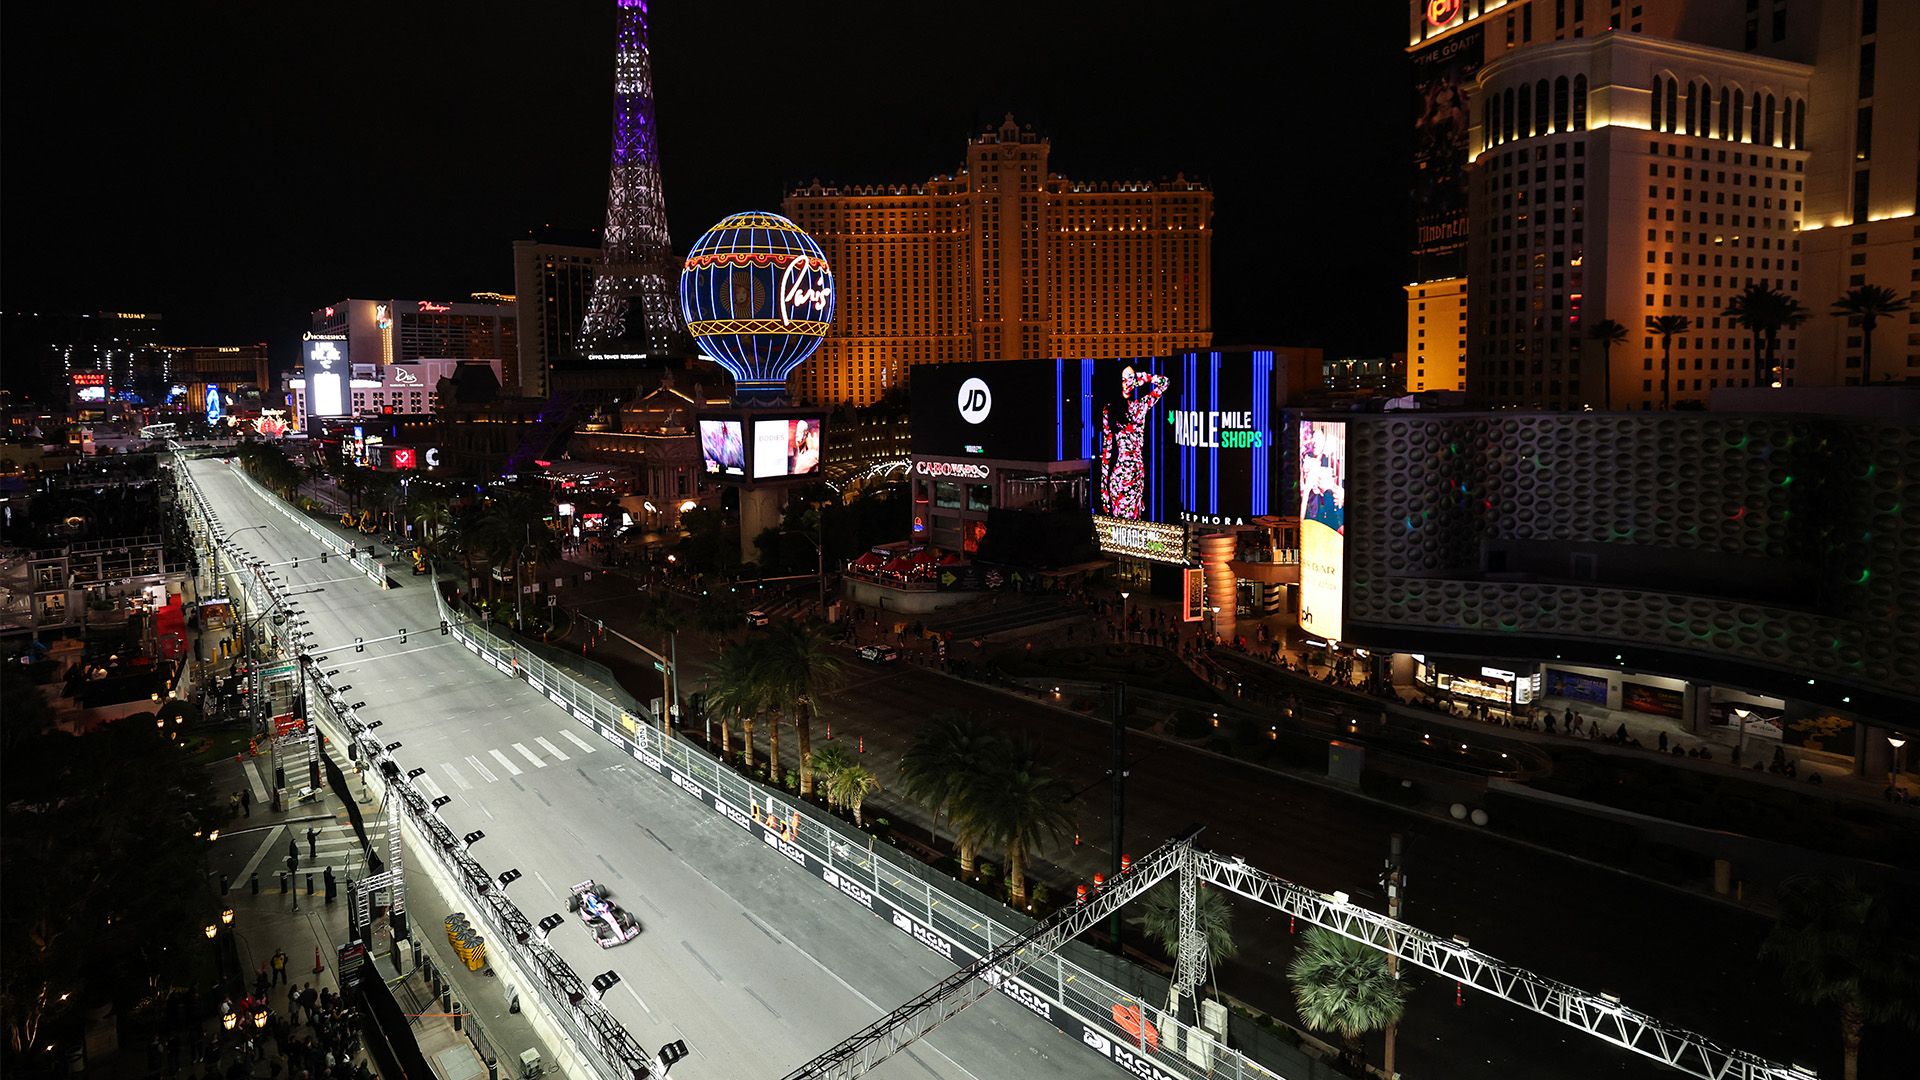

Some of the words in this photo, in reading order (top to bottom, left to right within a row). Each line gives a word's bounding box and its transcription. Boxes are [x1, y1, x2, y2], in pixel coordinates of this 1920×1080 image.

[781, 255, 832, 326] Paris
[963, 390, 987, 411] JD
[1222, 412, 1251, 428] MILE
[1222, 431, 1262, 448] SHOPS
[1180, 511, 1243, 526] SEPHORA
[1112, 526, 1147, 549] MIRACLE
[639, 727, 647, 748] 250
[727, 806, 750, 825] MGM
[778, 839, 805, 863] MGM
[840, 877, 872, 903] MGM
[913, 922, 952, 954] MGM
[914, 932, 954, 961] REWARDS
[1004, 980, 1051, 1014] MGM
[1004, 988, 1053, 1022] REWARDS
